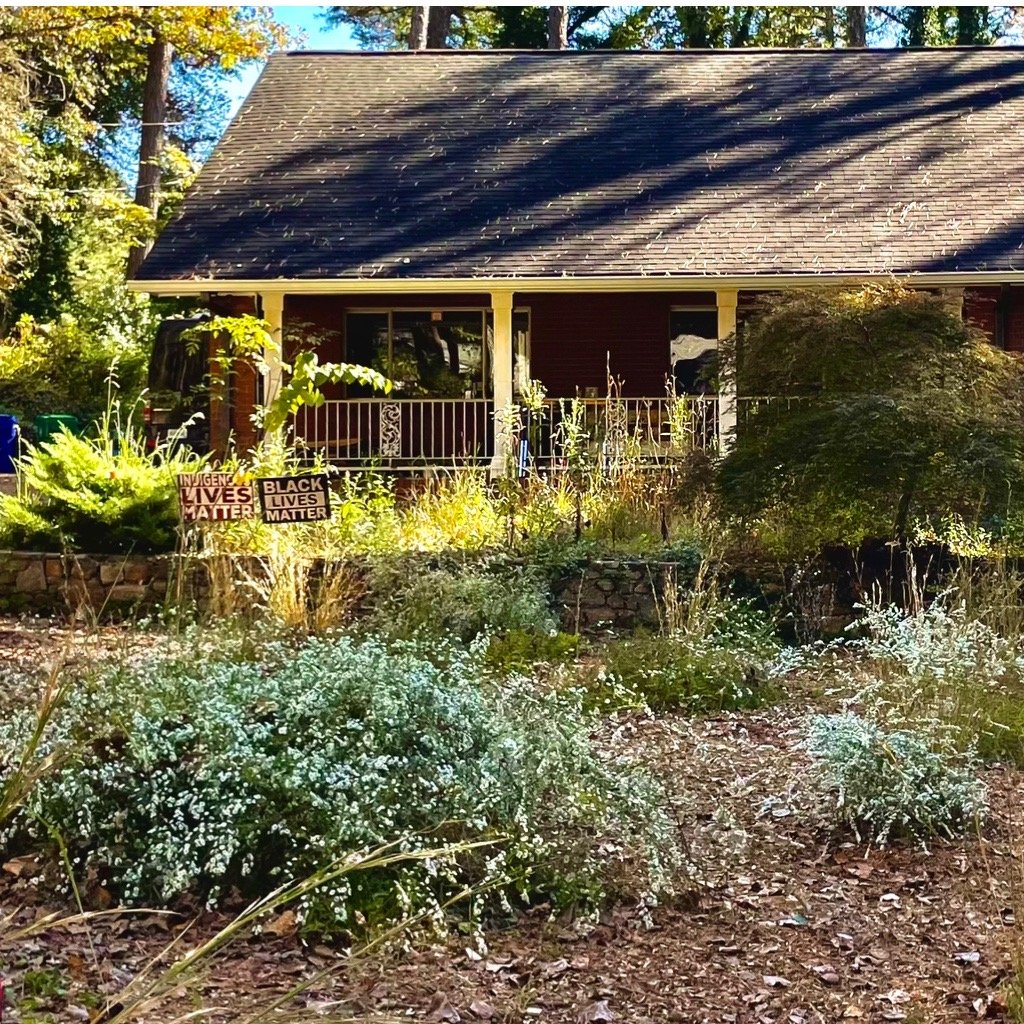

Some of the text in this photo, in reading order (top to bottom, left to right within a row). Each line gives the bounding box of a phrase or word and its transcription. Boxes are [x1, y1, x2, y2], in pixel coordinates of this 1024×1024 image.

[263, 477, 324, 494] BLACK
[181, 487, 252, 504] LIVES
[271, 493, 318, 507] LIVES
[183, 504, 255, 520] MATTER
[265, 507, 327, 521] MATTER
